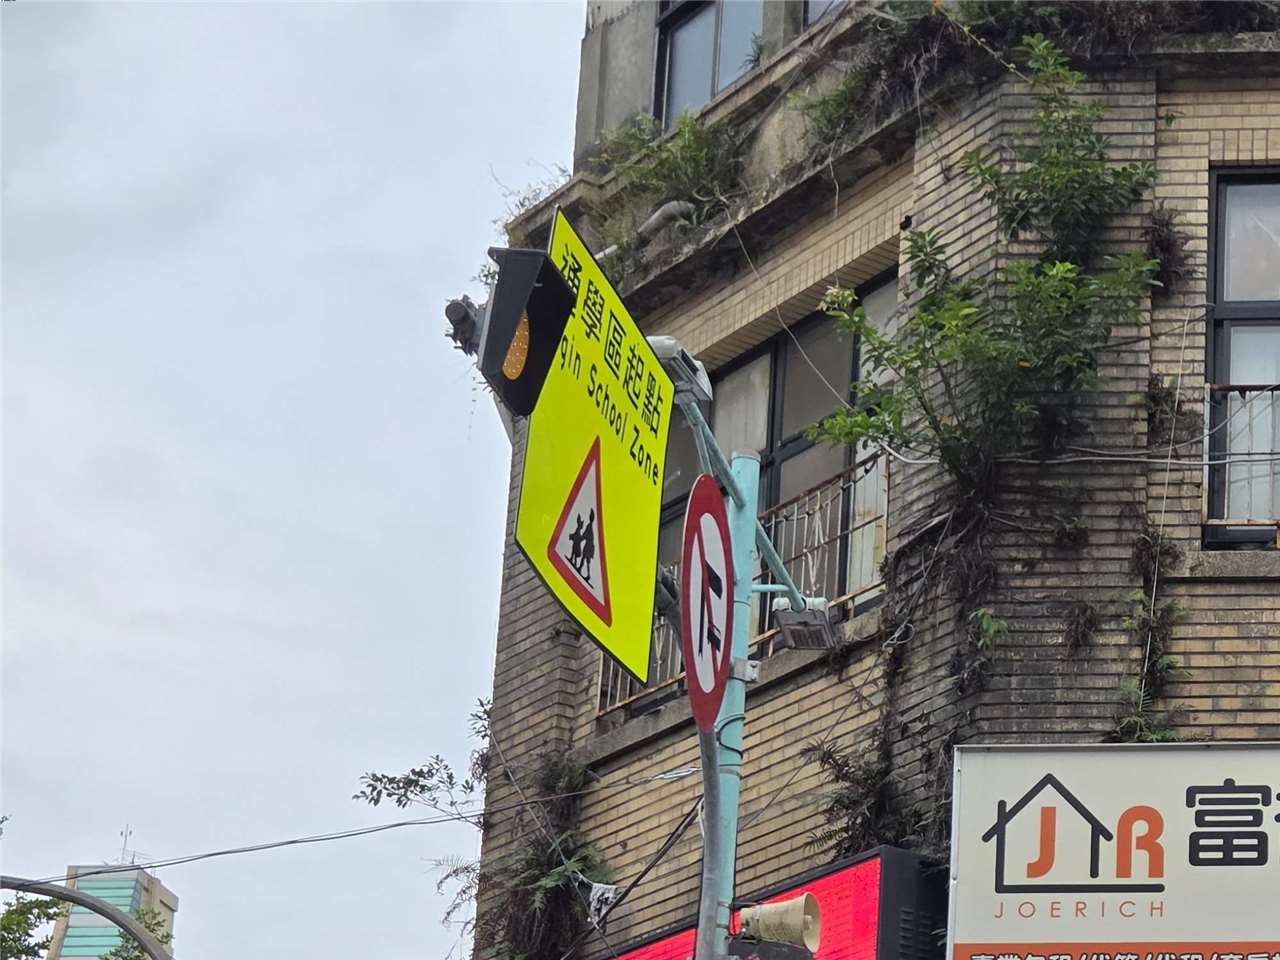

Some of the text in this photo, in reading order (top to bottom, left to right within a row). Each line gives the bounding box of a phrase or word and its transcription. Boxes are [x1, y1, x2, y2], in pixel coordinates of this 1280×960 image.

[559, 243, 663, 438] 通學區起點
[559, 333, 660, 486] gin School Zone
[995, 900, 1165, 918] JOERICH
